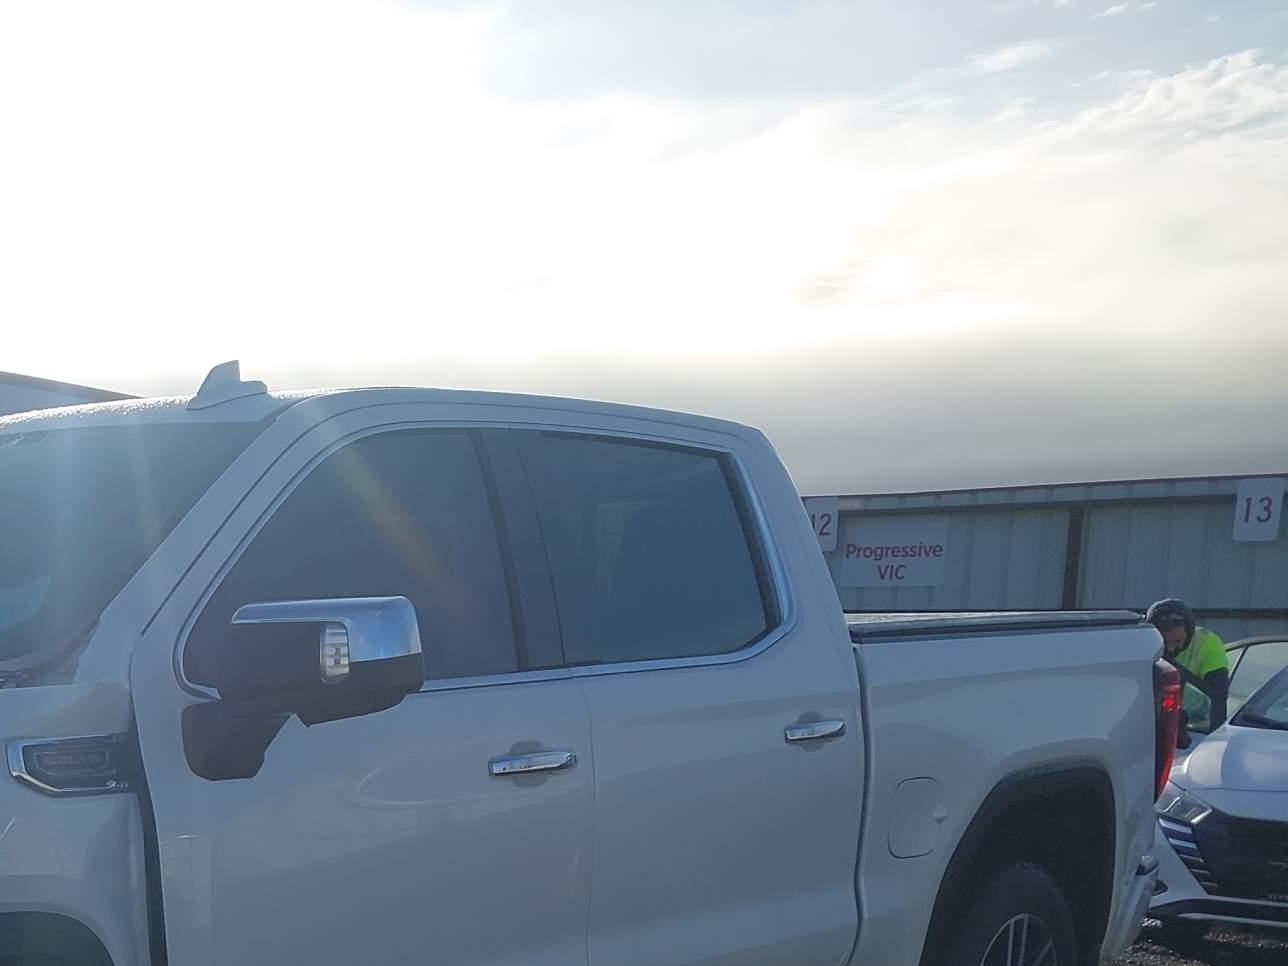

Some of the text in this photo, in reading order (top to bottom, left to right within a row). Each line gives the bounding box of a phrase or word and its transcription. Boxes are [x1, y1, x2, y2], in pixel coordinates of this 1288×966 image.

[1244, 496, 1273, 523] 13
[846, 541, 944, 561] Progressive
[876, 564, 907, 581] VIC
